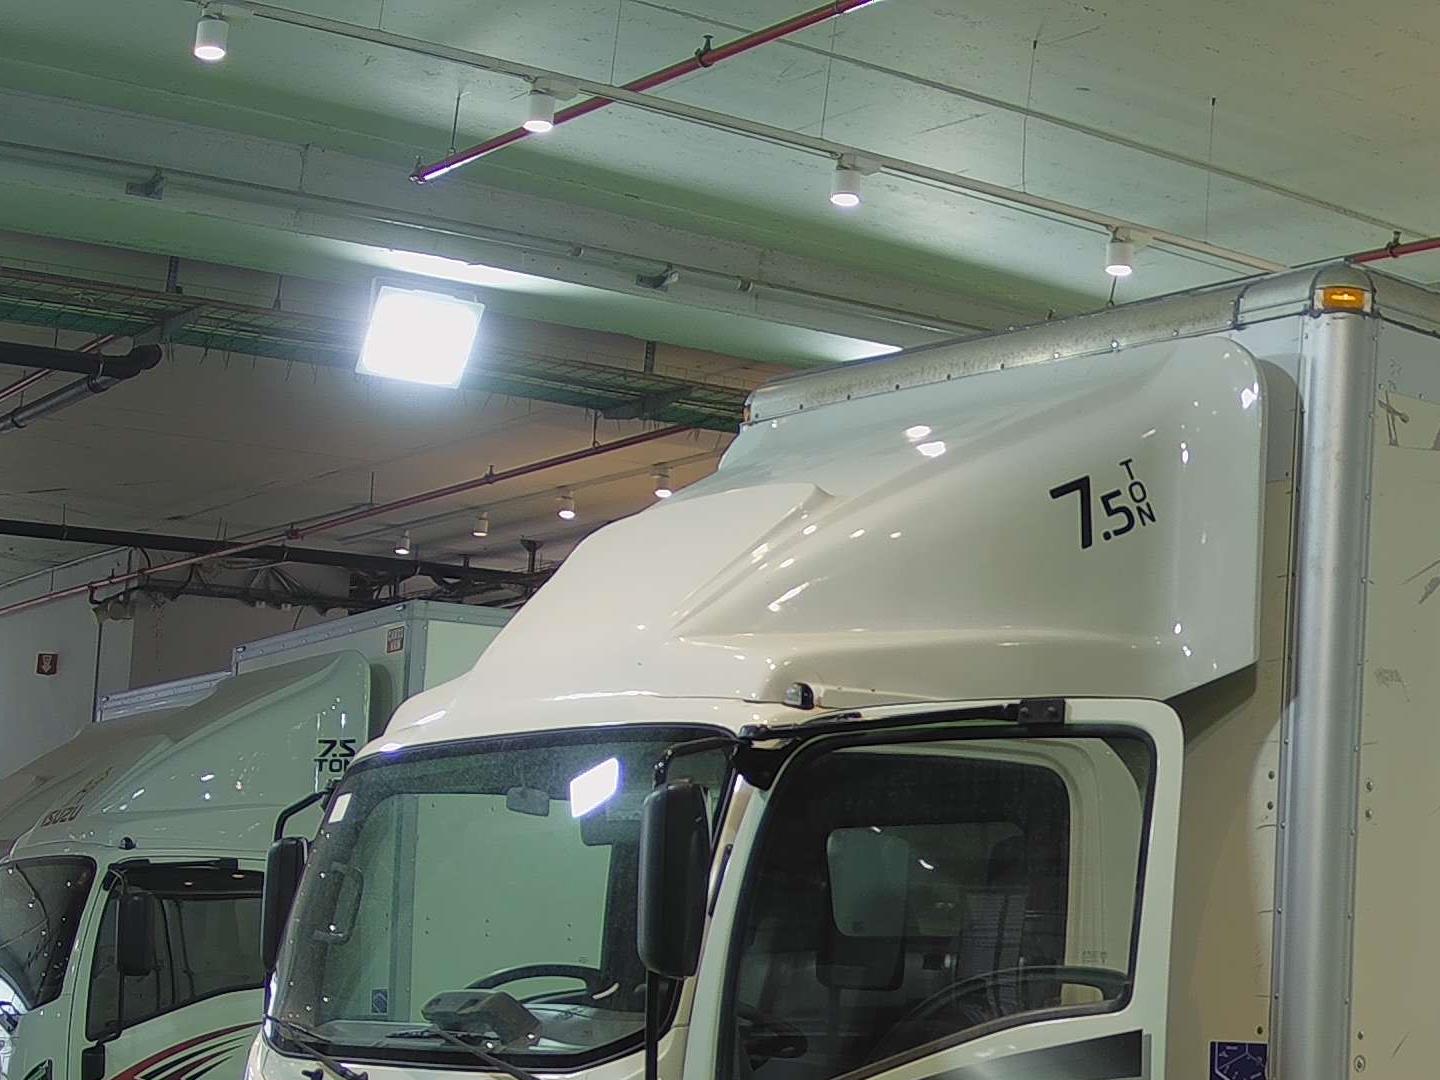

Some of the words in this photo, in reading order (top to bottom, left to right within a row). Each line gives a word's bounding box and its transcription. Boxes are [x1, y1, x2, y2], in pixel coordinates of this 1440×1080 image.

[1049, 474, 1135, 550] 7.5
[1118, 458, 1156, 527] TON
[317, 739, 357, 758] 7.5
